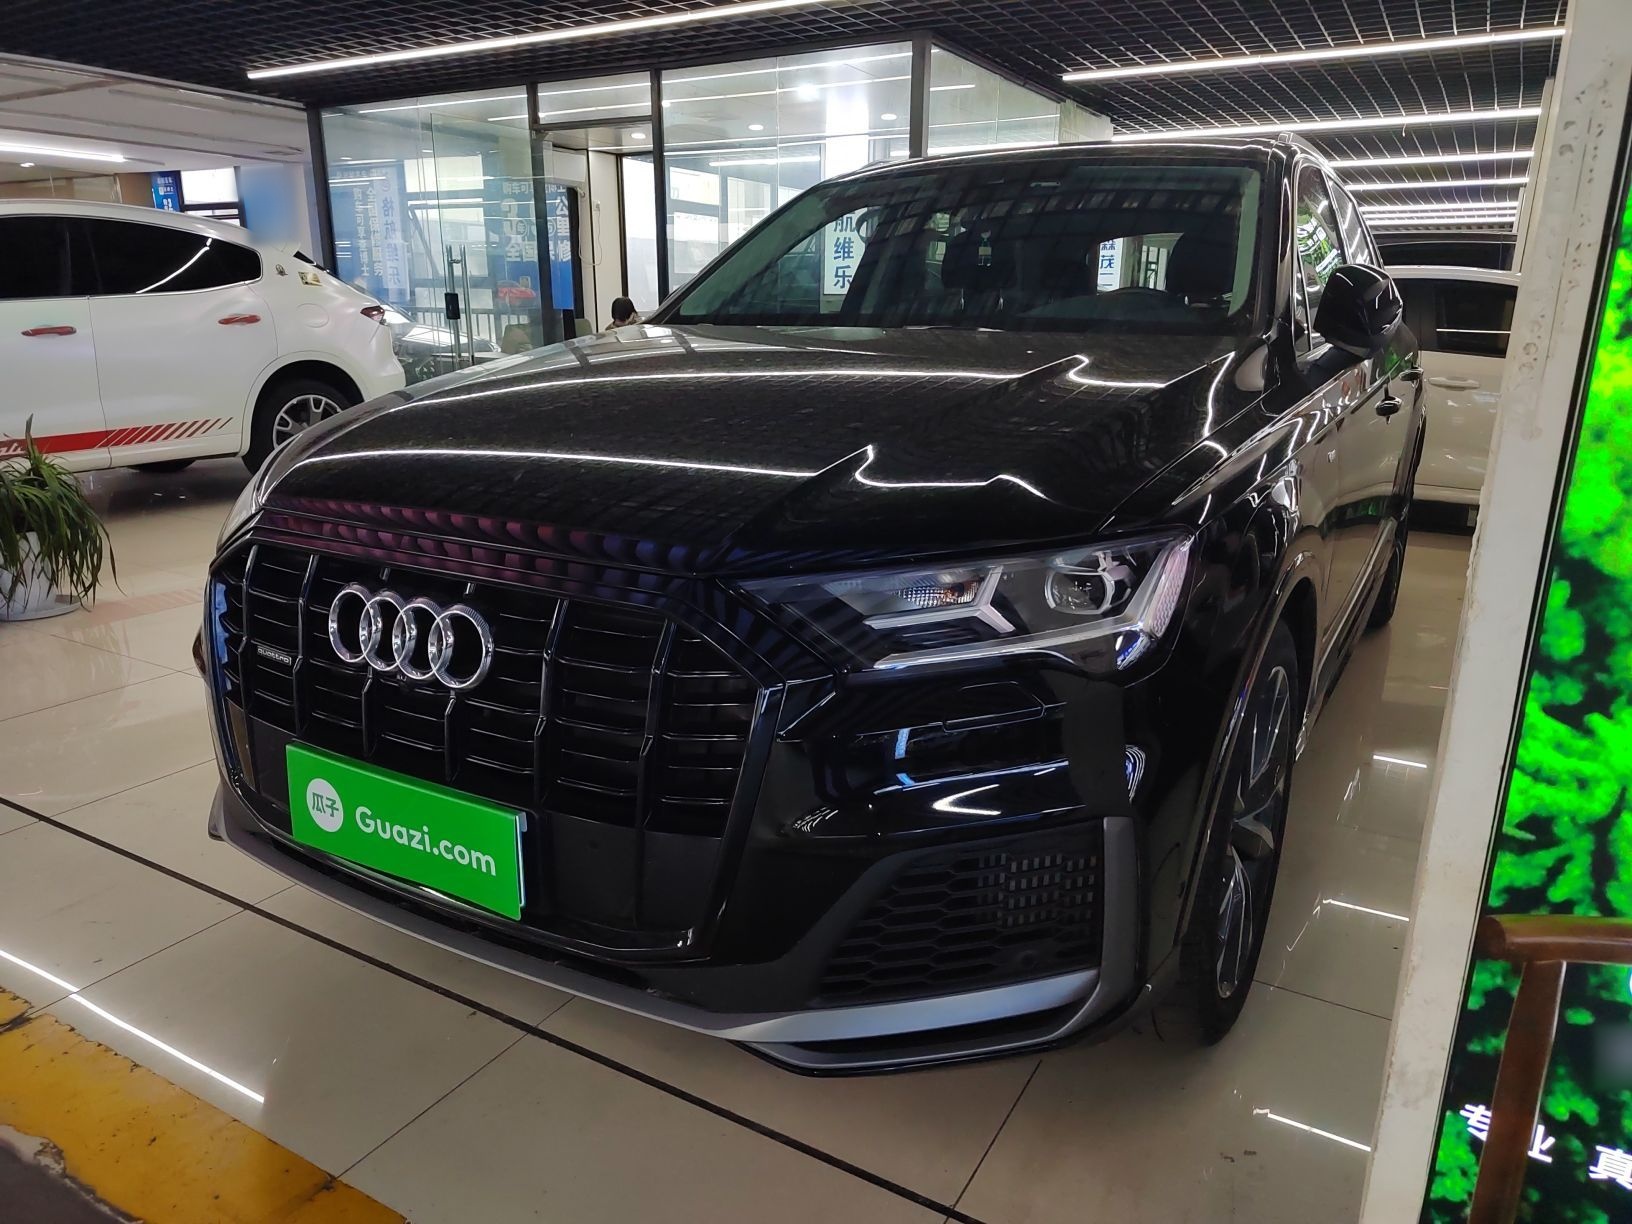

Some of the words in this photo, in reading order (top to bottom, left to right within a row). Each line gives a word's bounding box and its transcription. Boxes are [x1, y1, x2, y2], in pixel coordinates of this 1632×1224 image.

[257, 647, 290, 664] quattro
[312, 792, 339, 818] 瓜子
[355, 805, 497, 877] Guazi.com
